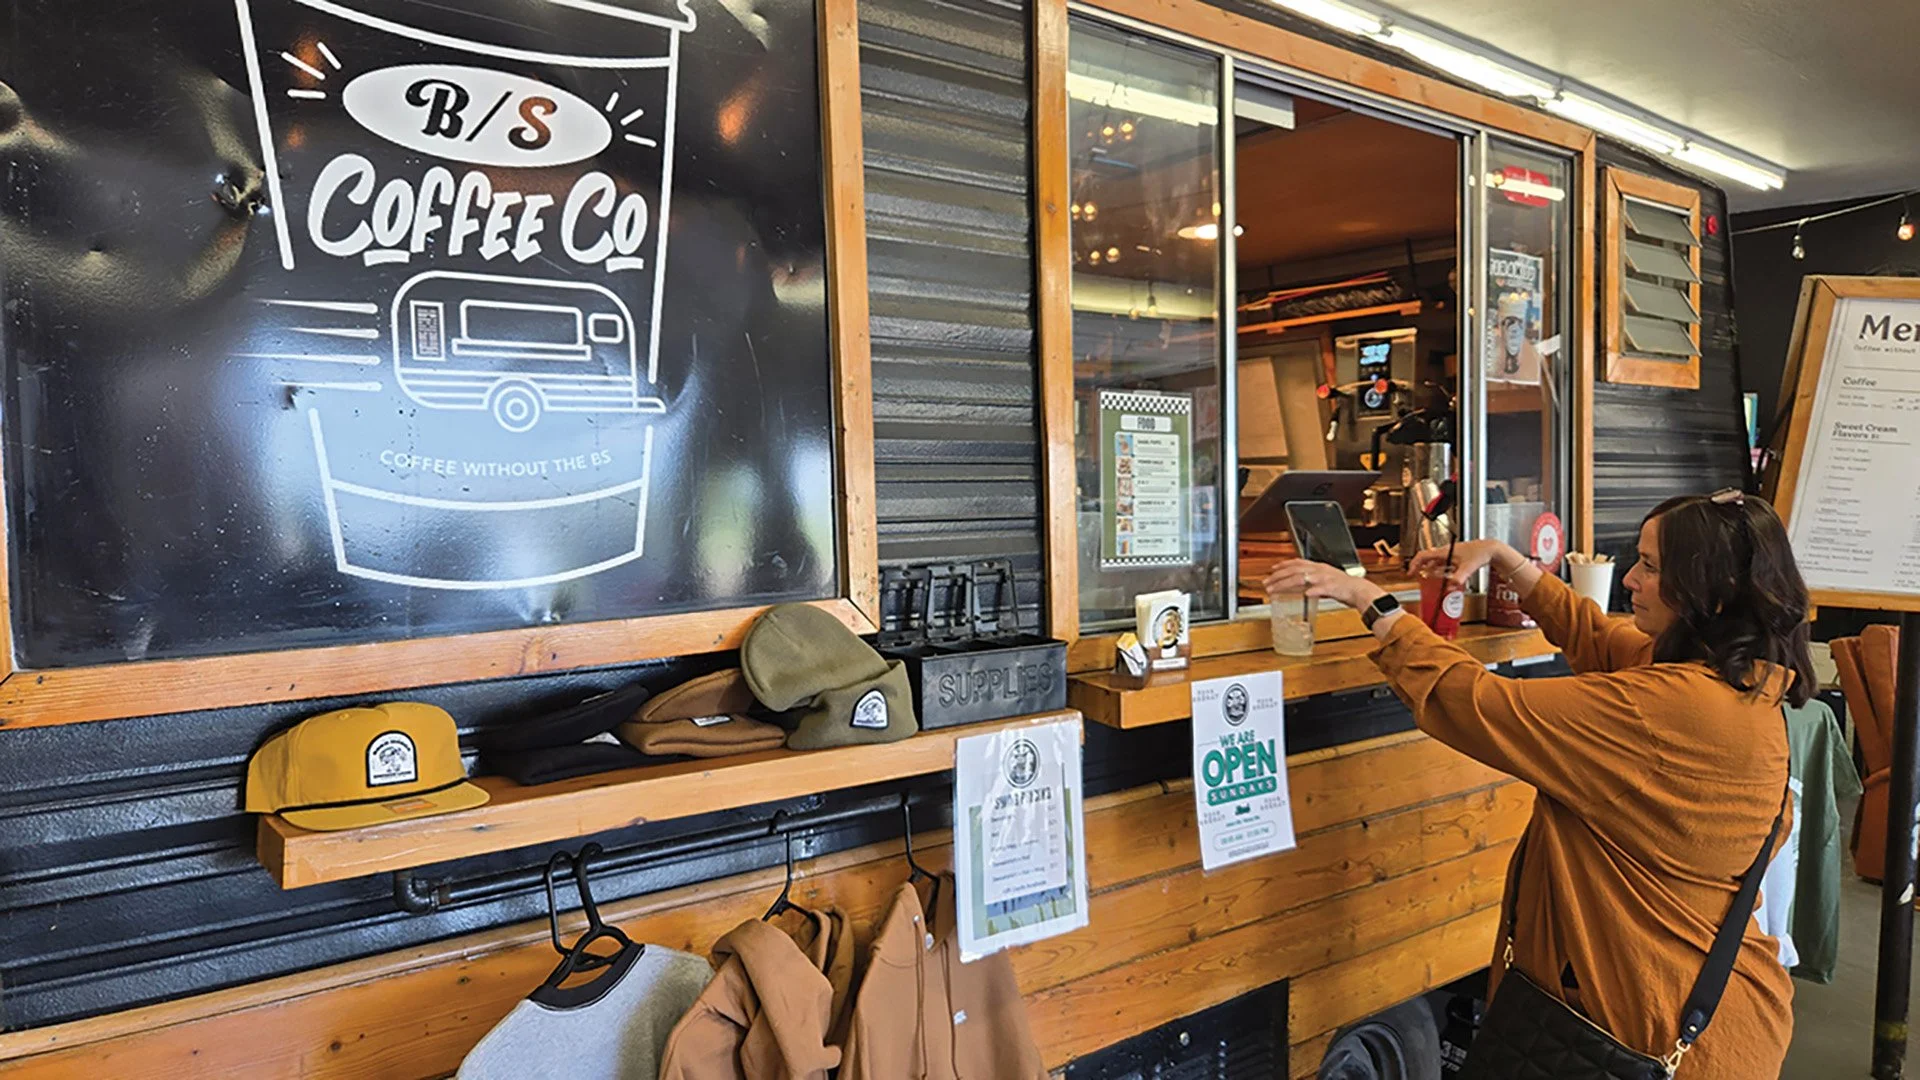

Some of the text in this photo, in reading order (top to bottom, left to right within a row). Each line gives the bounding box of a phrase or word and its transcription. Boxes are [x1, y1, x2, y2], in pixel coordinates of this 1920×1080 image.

[1843, 377, 1877, 387] Coffee
[1137, 416, 1156, 430] FOOD
[1834, 421, 1898, 433] Sweet Cream
[1832, 430, 1869, 439] Flavors
[380, 449, 612, 477] COFFEE WITHOUT THE BS
[939, 664, 1053, 707] SUPPLIES
[1219, 729, 1255, 748] WE ARE
[1203, 740, 1277, 787] OPEN
[1211, 779, 1274, 801] SUNDAYS
